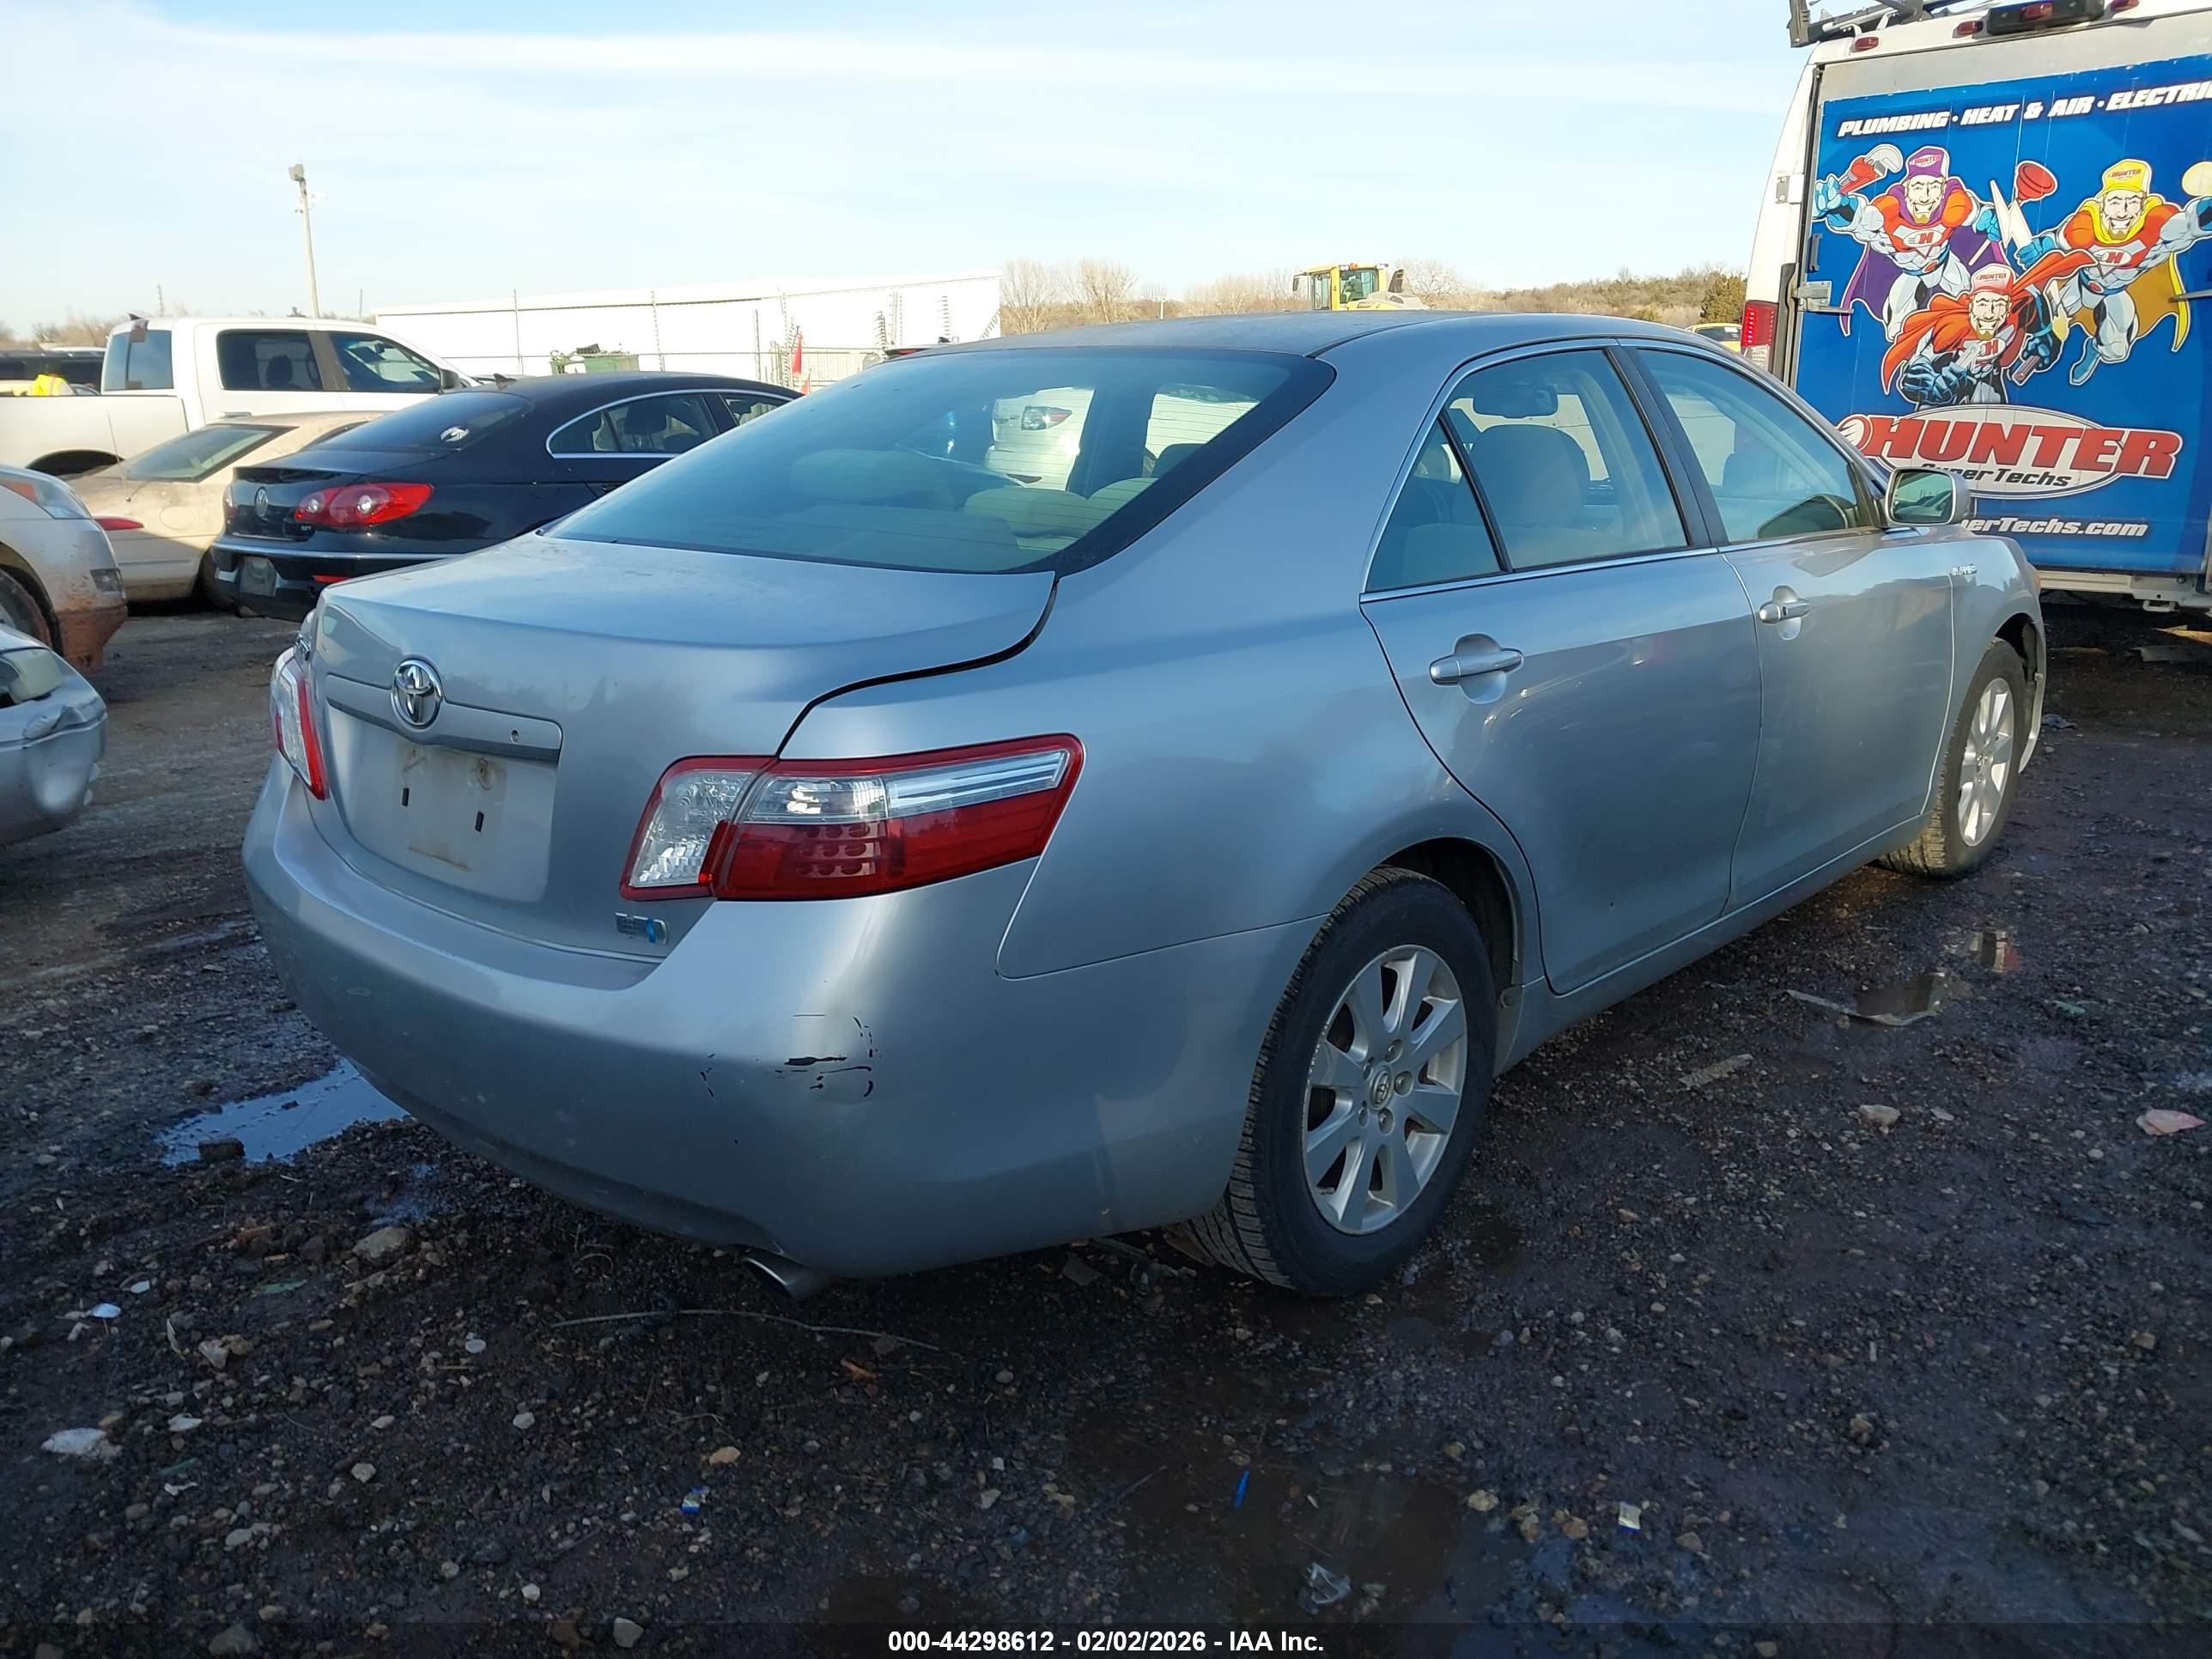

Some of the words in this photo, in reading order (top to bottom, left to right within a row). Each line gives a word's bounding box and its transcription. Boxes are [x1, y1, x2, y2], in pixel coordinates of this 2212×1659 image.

[1838, 112, 1950, 137] PLUMBING
[1960, 105, 2019, 125] HEAT
[2023, 102, 2043, 119] &
[2048, 95, 2095, 118] AIR
[1864, 417, 2180, 476] HUNTER
